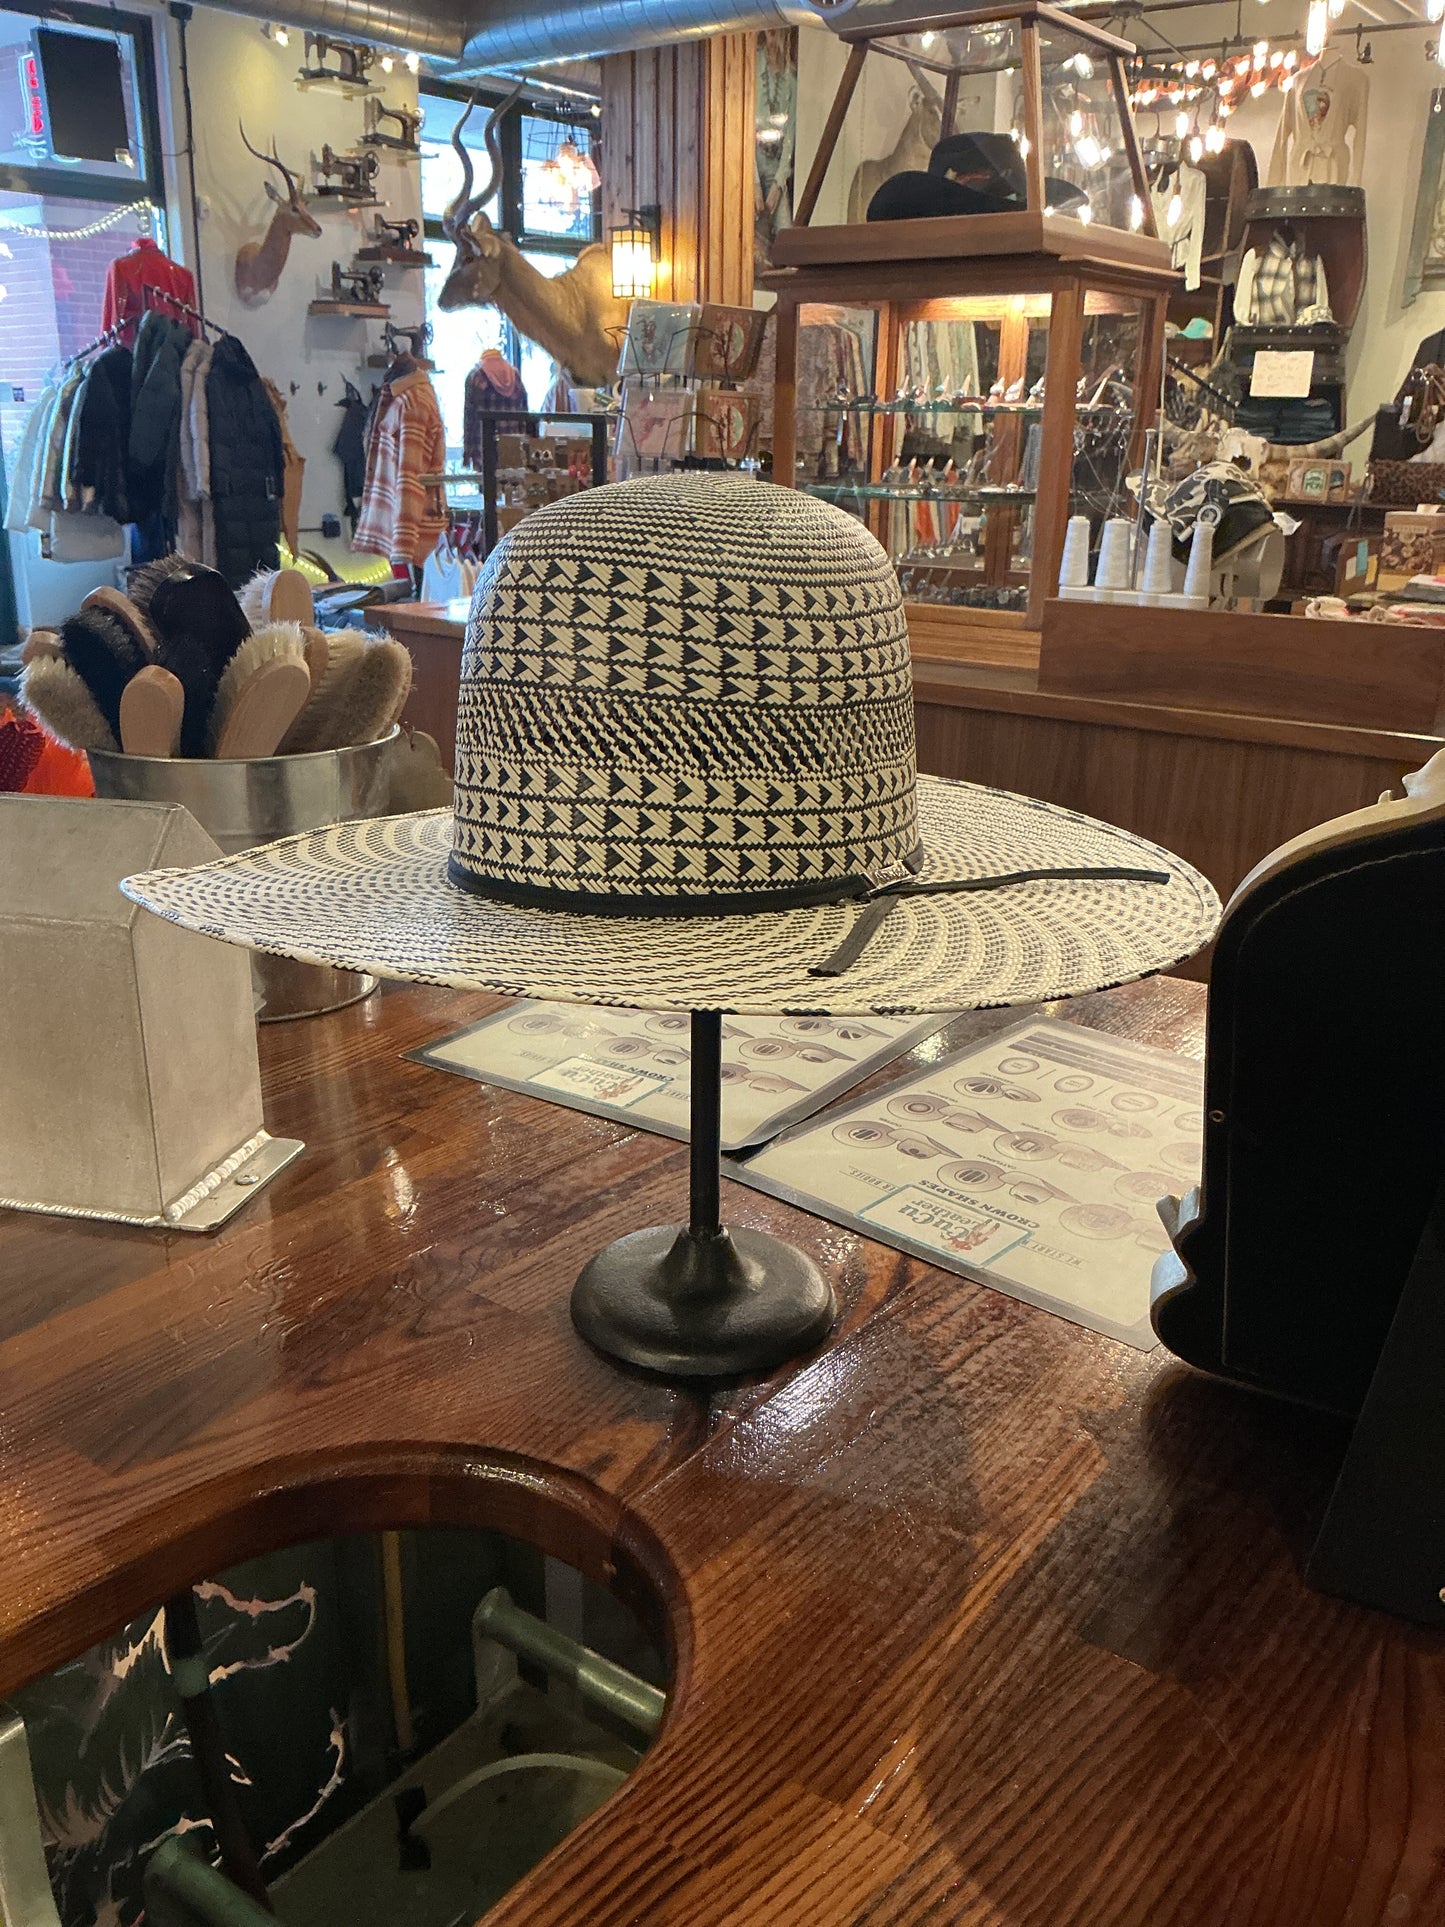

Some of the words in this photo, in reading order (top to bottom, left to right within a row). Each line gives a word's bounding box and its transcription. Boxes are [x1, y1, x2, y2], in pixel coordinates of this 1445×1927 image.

[560, 1071, 618, 1092] CuCu
[572, 1066, 627, 1082] Leather
[629, 1067, 675, 1082] CROWN
[917, 1180, 979, 1206] SHAPES
[898, 1204, 970, 1239] CuCu
[912, 1199, 983, 1228] Leather
[979, 1204, 1041, 1229] CROWN
[1033, 1244, 1063, 1258] START
